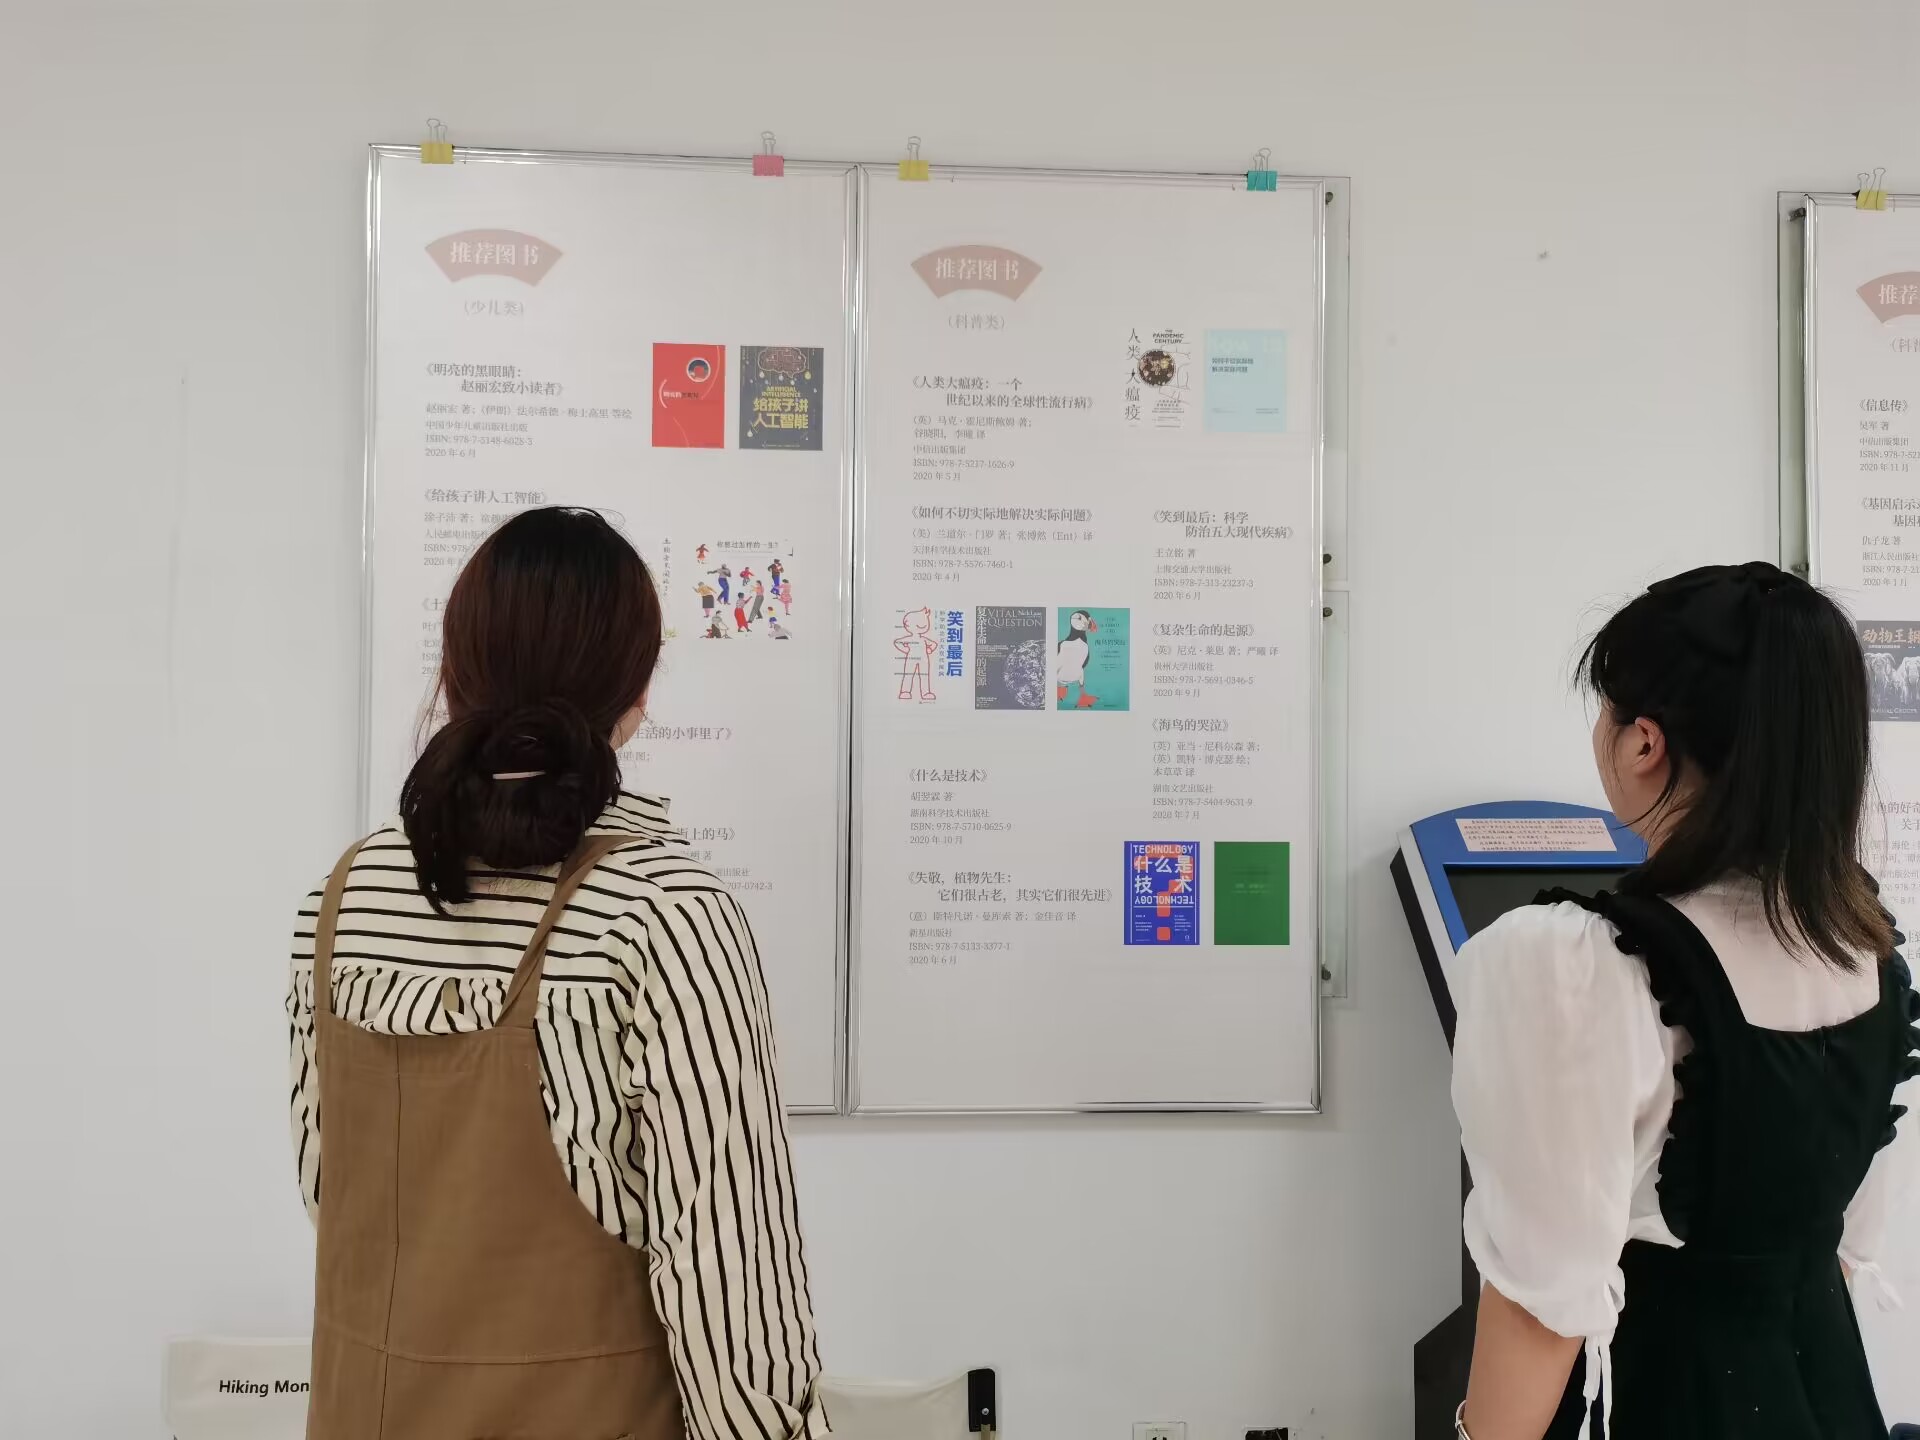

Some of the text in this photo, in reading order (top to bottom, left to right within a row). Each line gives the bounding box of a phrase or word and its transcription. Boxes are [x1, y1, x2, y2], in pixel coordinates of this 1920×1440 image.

[451, 242, 539, 266] 推荐图书
[935, 257, 1019, 280] 推荐图书
[1878, 284, 1920, 305] 推荐
[753, 398, 809, 413] 给孩子讲
[753, 413, 809, 429] 人工智能
[912, 505, 1095, 521] 《如何不切实际地解决实际问题》
[1186, 525, 1294, 539] 防治五大现代疾病》
[987, 608, 1017, 617] VITAL
[987, 618, 1042, 628] QUESTION
[1153, 624, 1255, 637] 《复杂生命的起源》
[946, 611, 964, 677] 笑到最后
[1152, 718, 1229, 732] 《海鸟的哭泣》
[909, 768, 987, 783] 《什么是技术》
[1133, 844, 1194, 854] TECHNOLOGY
[1134, 855, 1193, 874] 什么是
[219, 1380, 310, 1398] Hiking Mon
